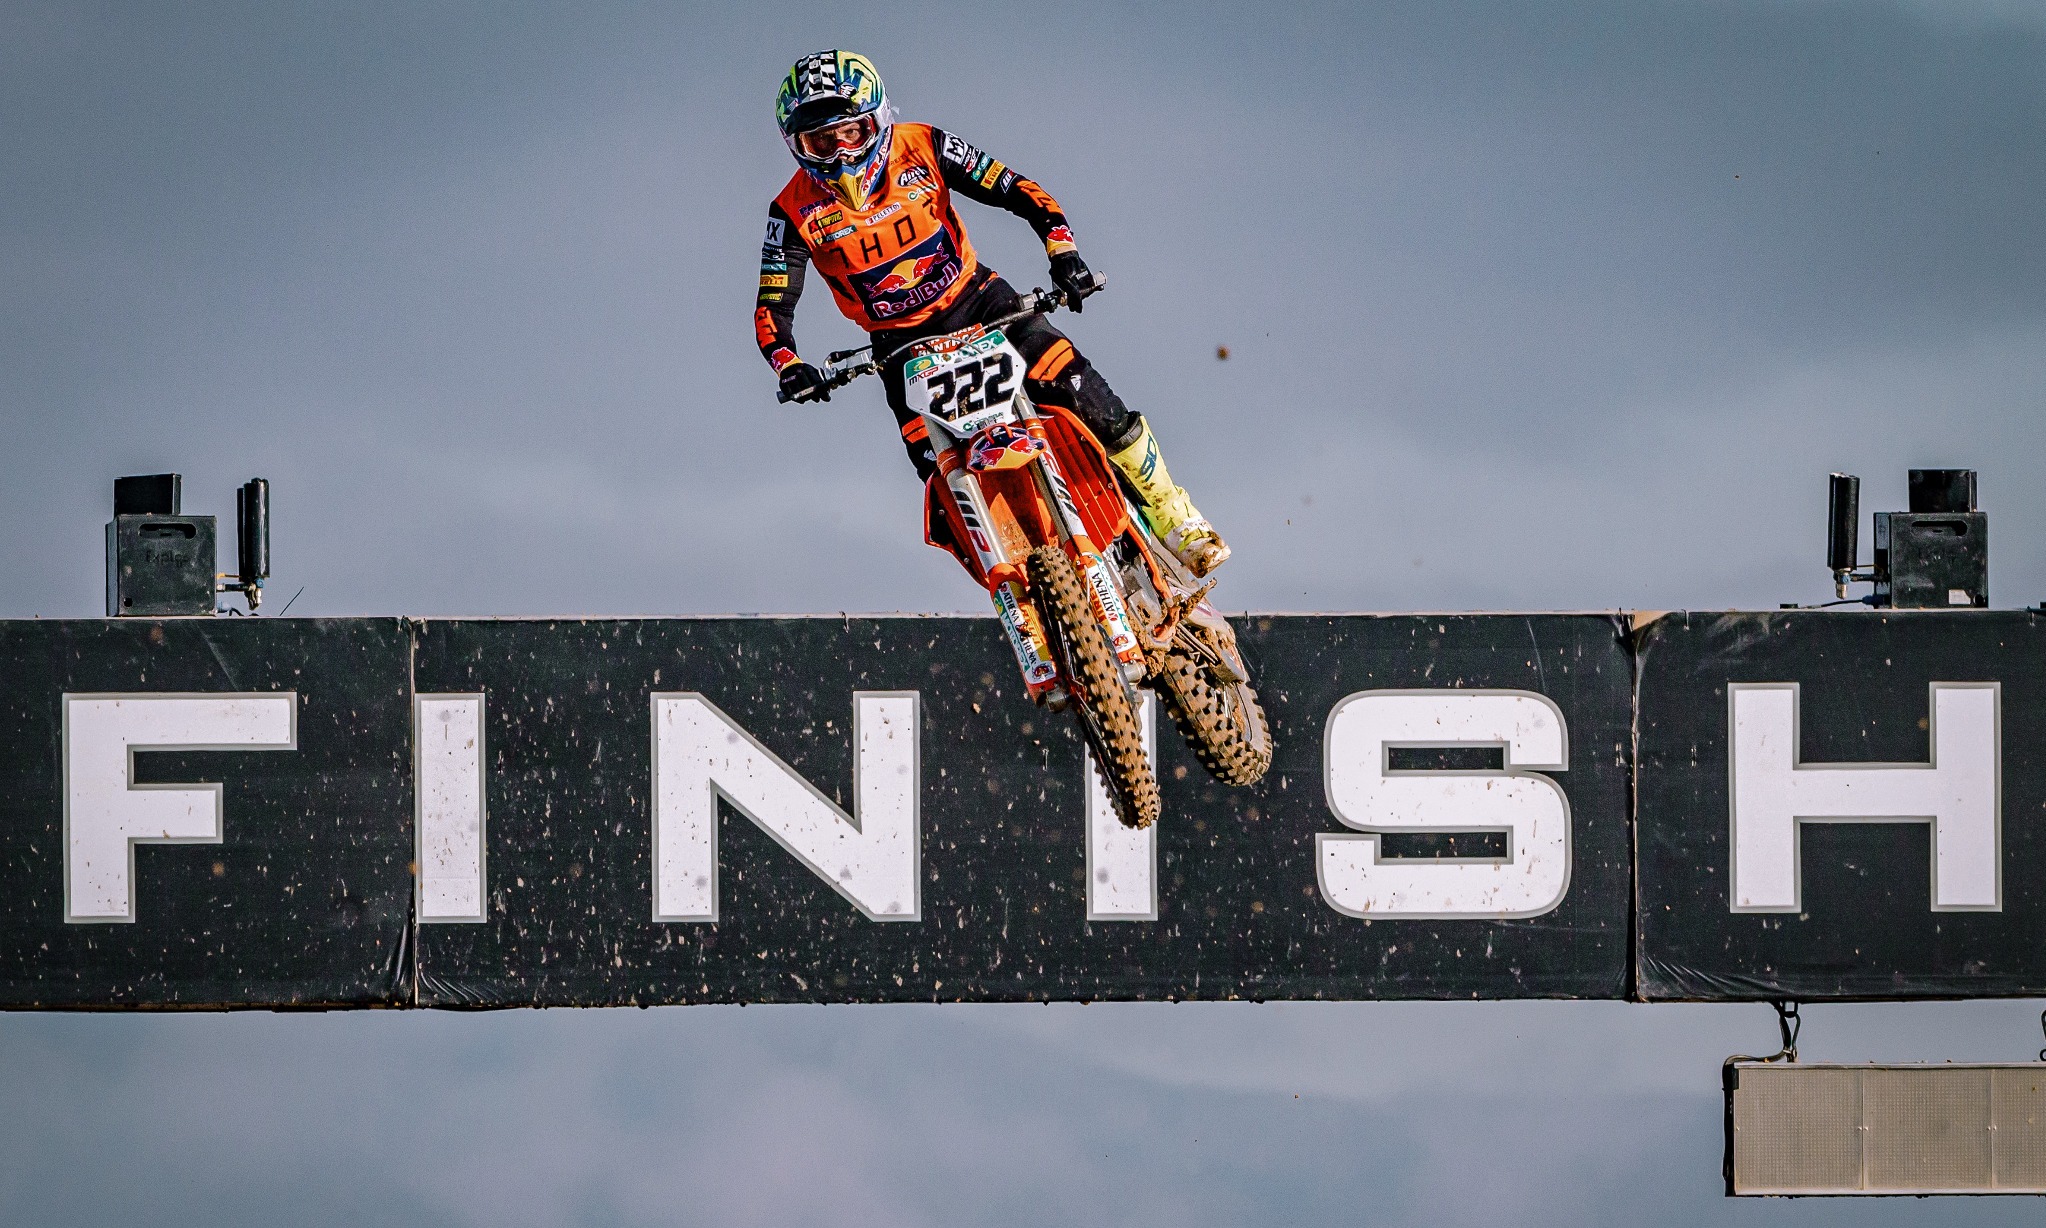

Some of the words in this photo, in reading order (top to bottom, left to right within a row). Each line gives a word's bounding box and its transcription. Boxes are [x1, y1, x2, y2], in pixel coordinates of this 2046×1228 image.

[872, 287, 923, 319] Red
[917, 260, 960, 302] Bull
[927, 352, 1016, 423] 222
[1003, 591, 1021, 623] ATHENA
[1092, 572, 1117, 613] ATHENA
[62, 681, 2002, 924] FINISH
